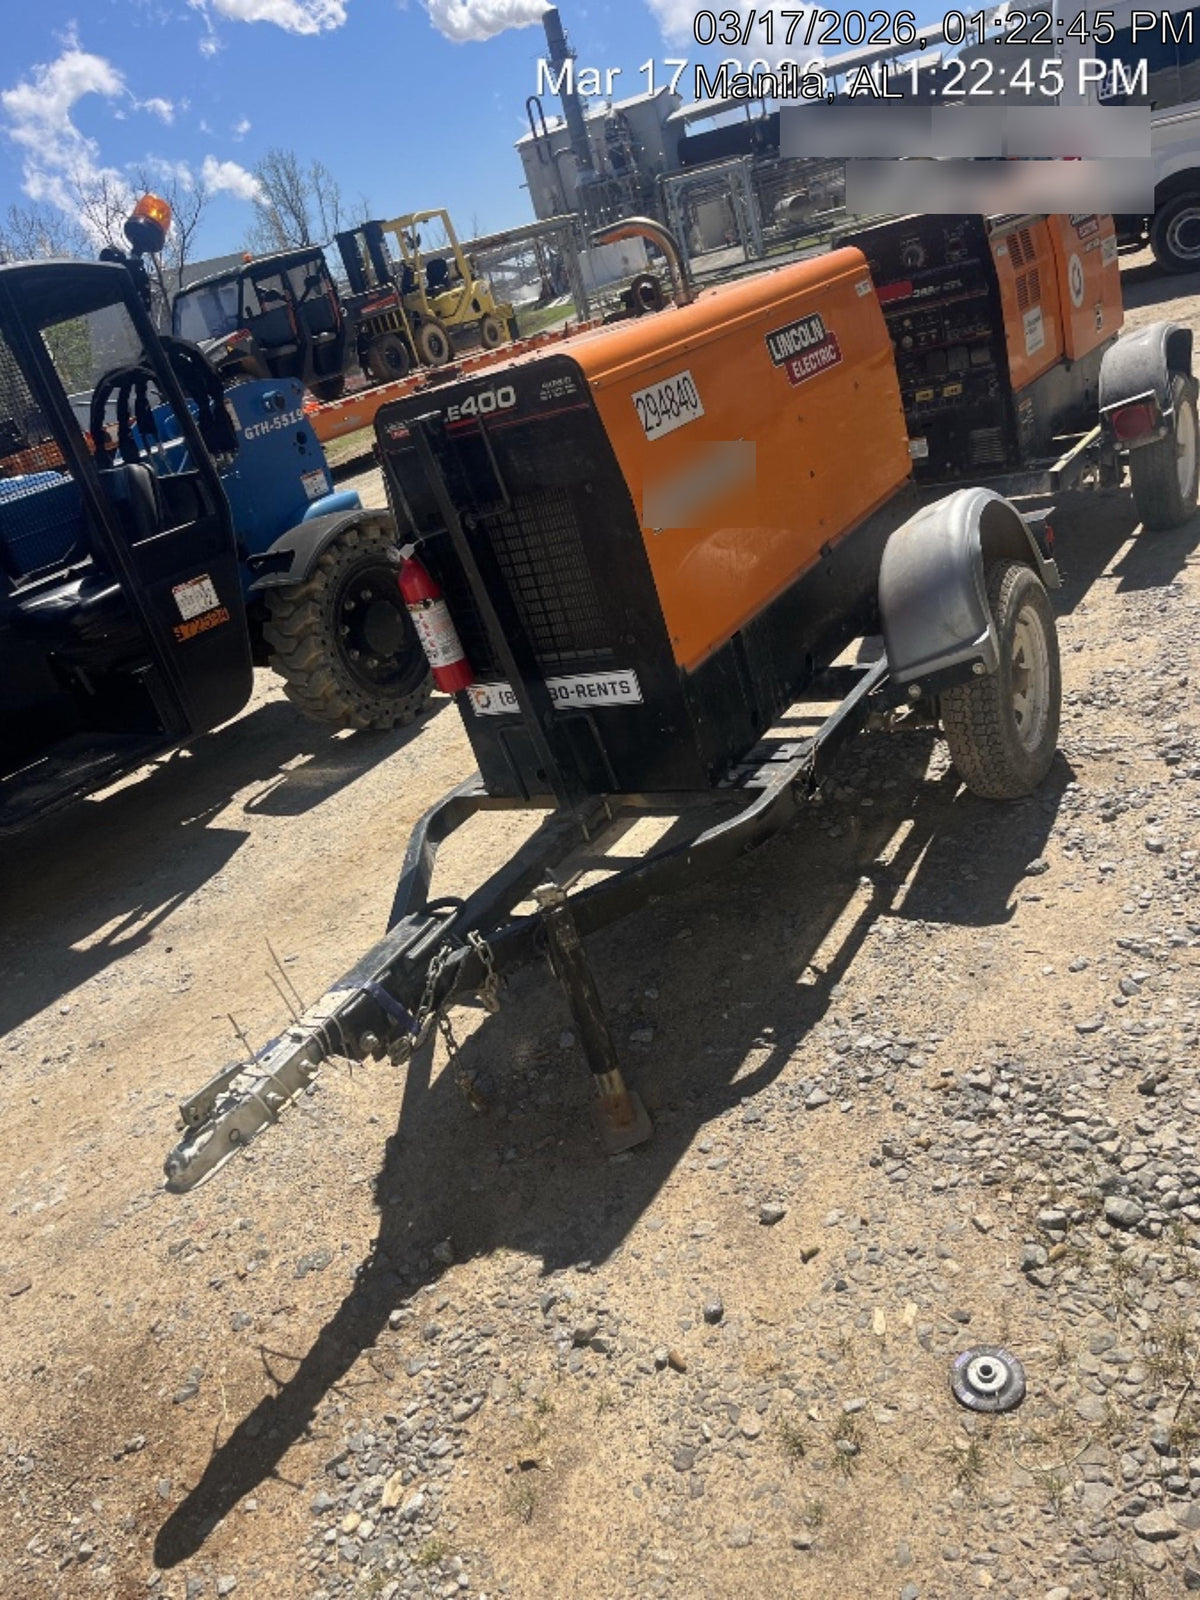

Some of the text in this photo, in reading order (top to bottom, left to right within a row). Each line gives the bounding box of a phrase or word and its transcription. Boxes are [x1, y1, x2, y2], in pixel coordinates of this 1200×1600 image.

[768, 315, 825, 361] LINCOLN
[791, 343, 838, 379] ELECTRIC
[244, 408, 305, 440] GTH-5519
[634, 375, 699, 433] 294840
